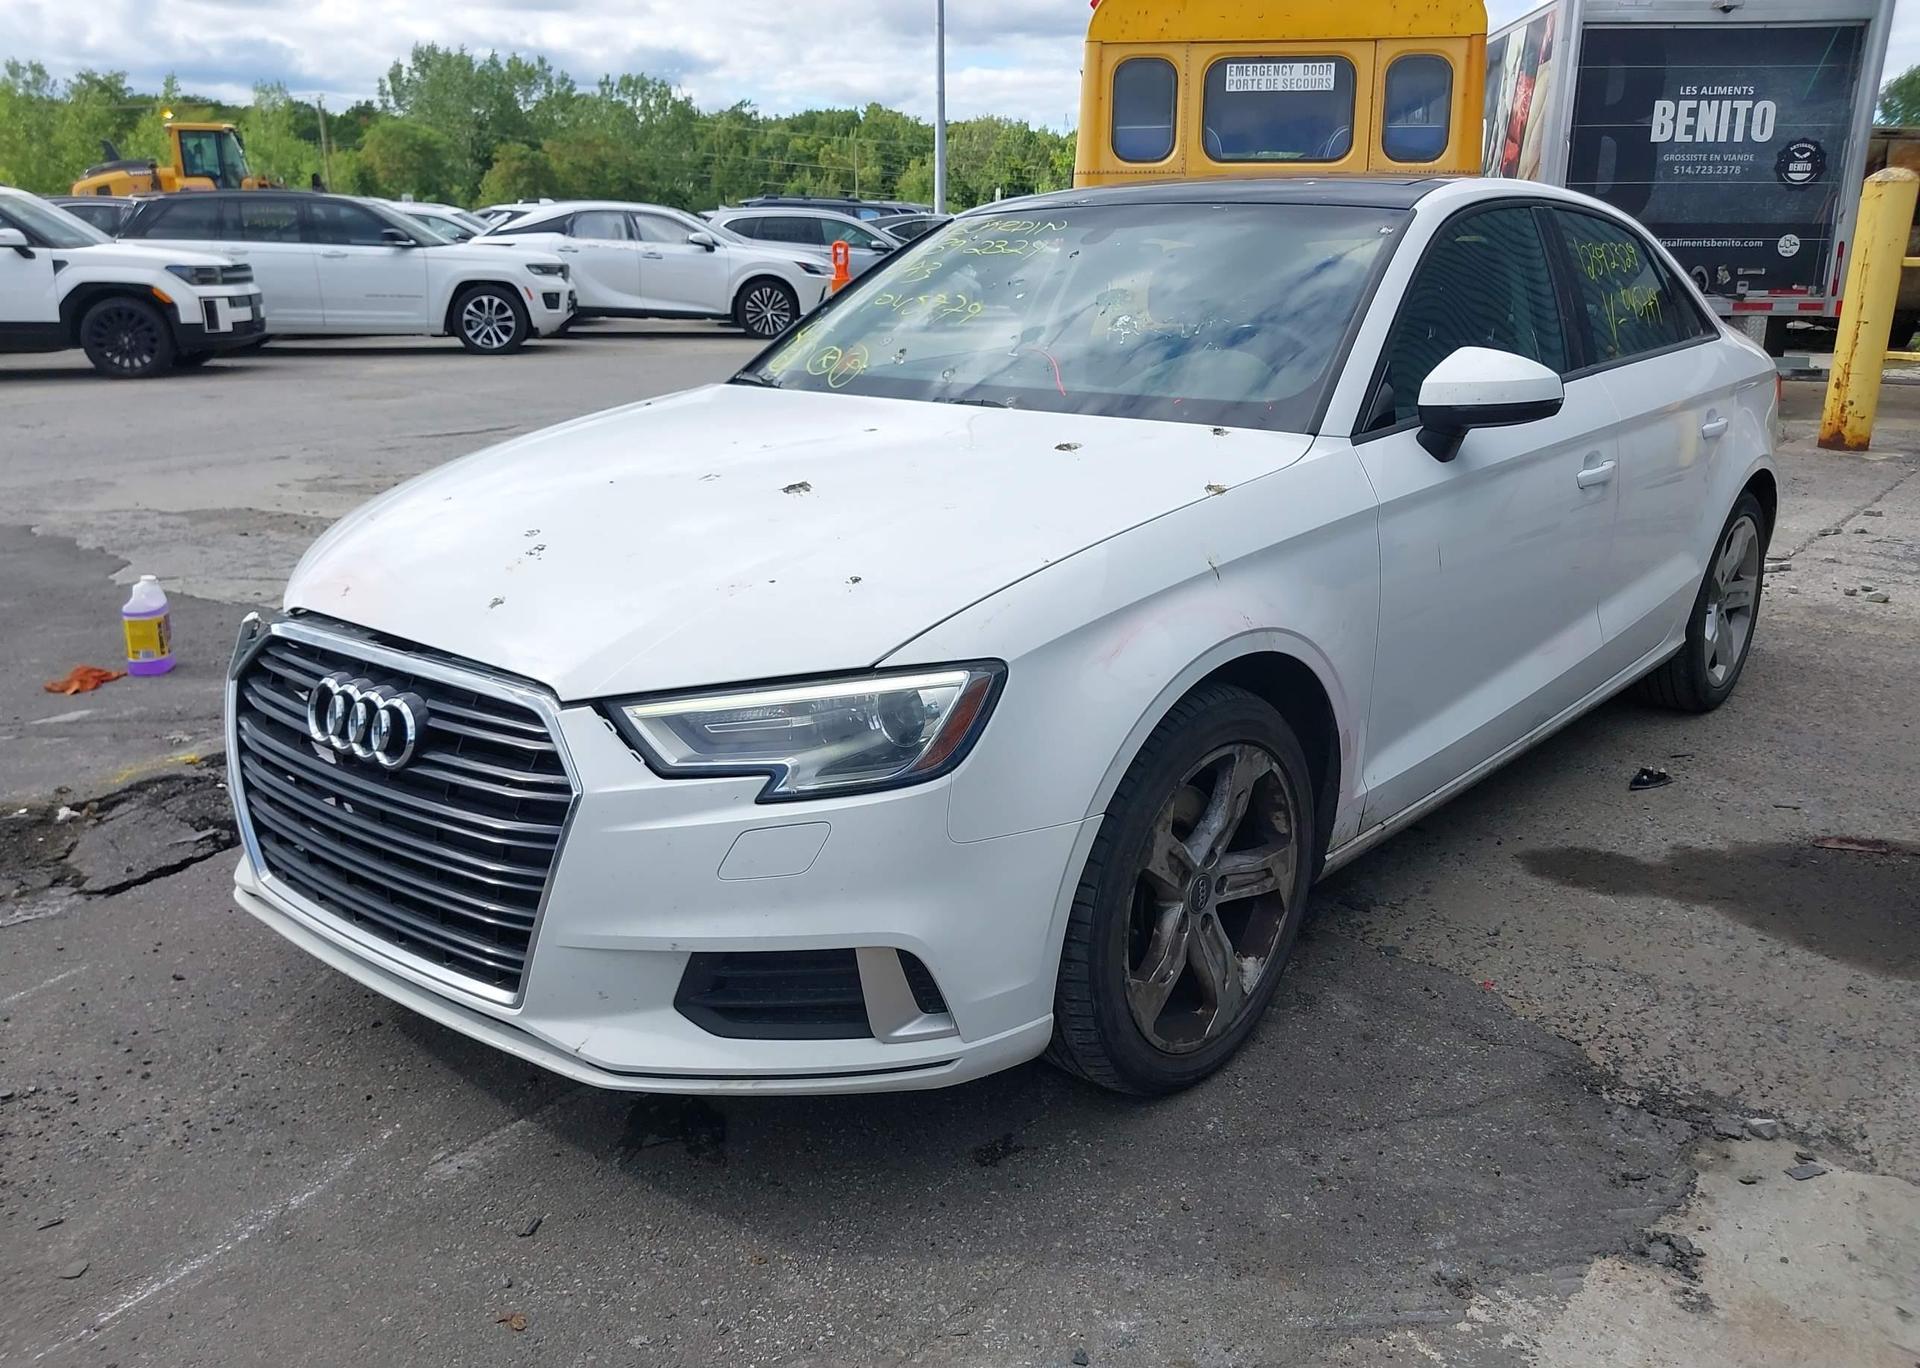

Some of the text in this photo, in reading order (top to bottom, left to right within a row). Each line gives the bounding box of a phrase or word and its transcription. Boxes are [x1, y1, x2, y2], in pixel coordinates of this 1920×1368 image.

[1228, 64, 1332, 77] EMERGENCY DOOR
[1228, 78, 1331, 90] PORTE DE SECOURS
[1679, 86, 1755, 95] LES ALIMENTS
[1650, 100, 1777, 142] BENITO
[1663, 153, 1755, 162] GROSSISTE EN VIANDE
[1673, 165, 1741, 175] 514.723.2378
